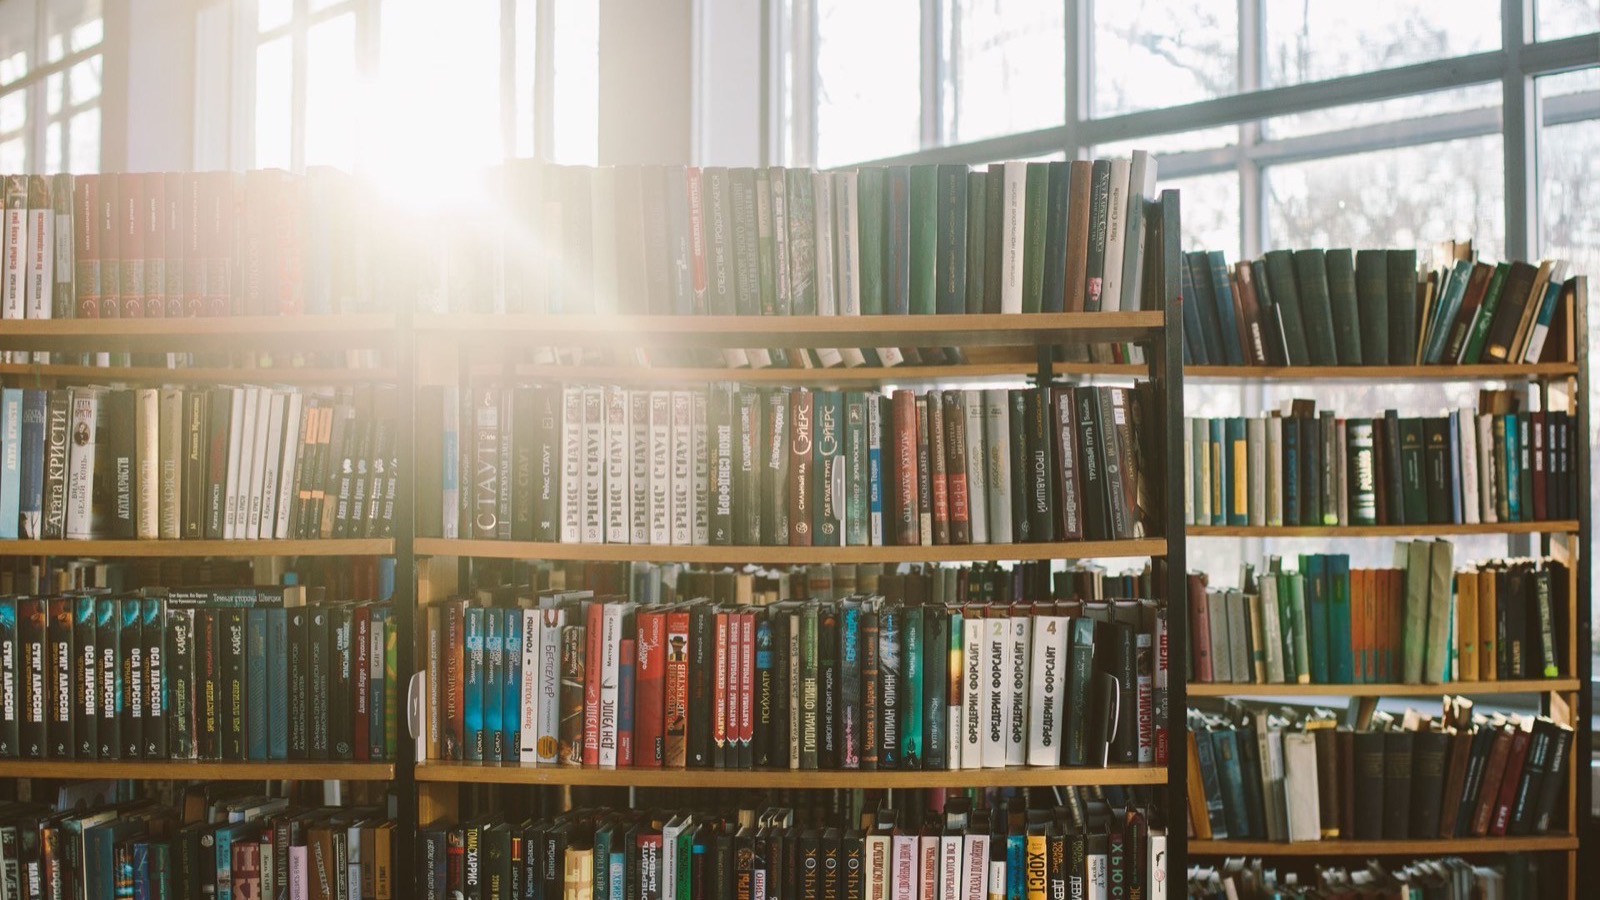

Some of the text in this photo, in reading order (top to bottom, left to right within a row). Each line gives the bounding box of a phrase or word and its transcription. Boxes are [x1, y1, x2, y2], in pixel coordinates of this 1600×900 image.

[48, 408, 67, 528] Агата КРИСТИ
[542, 442, 551, 476] СТАУТ
[717, 425, 731, 516] ДЖОН СЭНДФОРД
[920, 449, 928, 508] КРАСНАЯ ДВЕРЬ
[1035, 449, 1047, 514] ПРОПАВШИЙ
[1084, 426, 1097, 481] ТРУДНЫЙ ПУТЬ
[117, 456, 130, 520] АГАТА КРИСТИ
[476, 440, 498, 531] СТАУТ
[903, 507, 912, 523] ПО
[3, 641, 14, 722] СТИГ ЛАРССОН
[32, 642, 43, 723] СТИГ ЛАРССОН
[59, 642, 70, 723] СТИГ ЛАРССОН
[85, 645, 96, 716] ОСА ЛАРССОН
[104, 648, 115, 719] ОСА ЛАРССОН
[131, 648, 142, 718] ОСА ЛАРССОН
[151, 647, 162, 717] ОСА ЛАРССОН
[524, 616, 535, 730] Эдгар УОЛЛЕС РОМАНЫ
[544, 644, 557, 699] БЕСТСЕЛЛЕР
[676, 663, 686, 718] ДЕТЕКТИВ
[718, 648, 726, 690] СЕКРЕТНЫЙ
[743, 644, 751, 684] ПРОПАВШИЙ
[990, 621, 1003, 743] ФРЕДЕРИК ФОРСАЙТ 2
[1012, 623, 1025, 745] ФРЕДЕРИК ФОРСАЙТ 3
[1042, 620, 1057, 747] ФРЕДЕРИК ФОРСАЙТ 4
[448, 674, 457, 720] ДРАКОНА
[584, 700, 598, 730] УЭЛЛС
[601, 700, 615, 730] УЭЛЛС
[667, 663, 677, 731] ФРАНЦУЗСКИЙ
[717, 698, 725, 736] ФАНТОМАС
[742, 692, 750, 728] ФАНТОМАС
[760, 670, 771, 724] ПСИХИАТР
[803, 677, 816, 753] ГИЛЛИАН ФЛИНН
[826, 715, 834, 724] НЕ
[883, 674, 896, 750] ГИЛЛИАН ФЛИНН
[968, 642, 980, 745] ФРЕДЕРИК ФОРСАЙТ
[584, 731, 599, 750] ДЭН
[601, 731, 615, 750] ДЭН
[525, 839, 535, 898] Красный дракон
[545, 839, 556, 881] Ганнибал
[649, 840, 657, 893] ДЬЯВОЛА
[897, 860, 912, 889] ДВОЙНЫМ
[946, 842, 956, 855] ВСЕ
[968, 840, 984, 893] СКАЗАЛ ПОКОЙНИК
[1029, 852, 1046, 894] ХОРСТ
